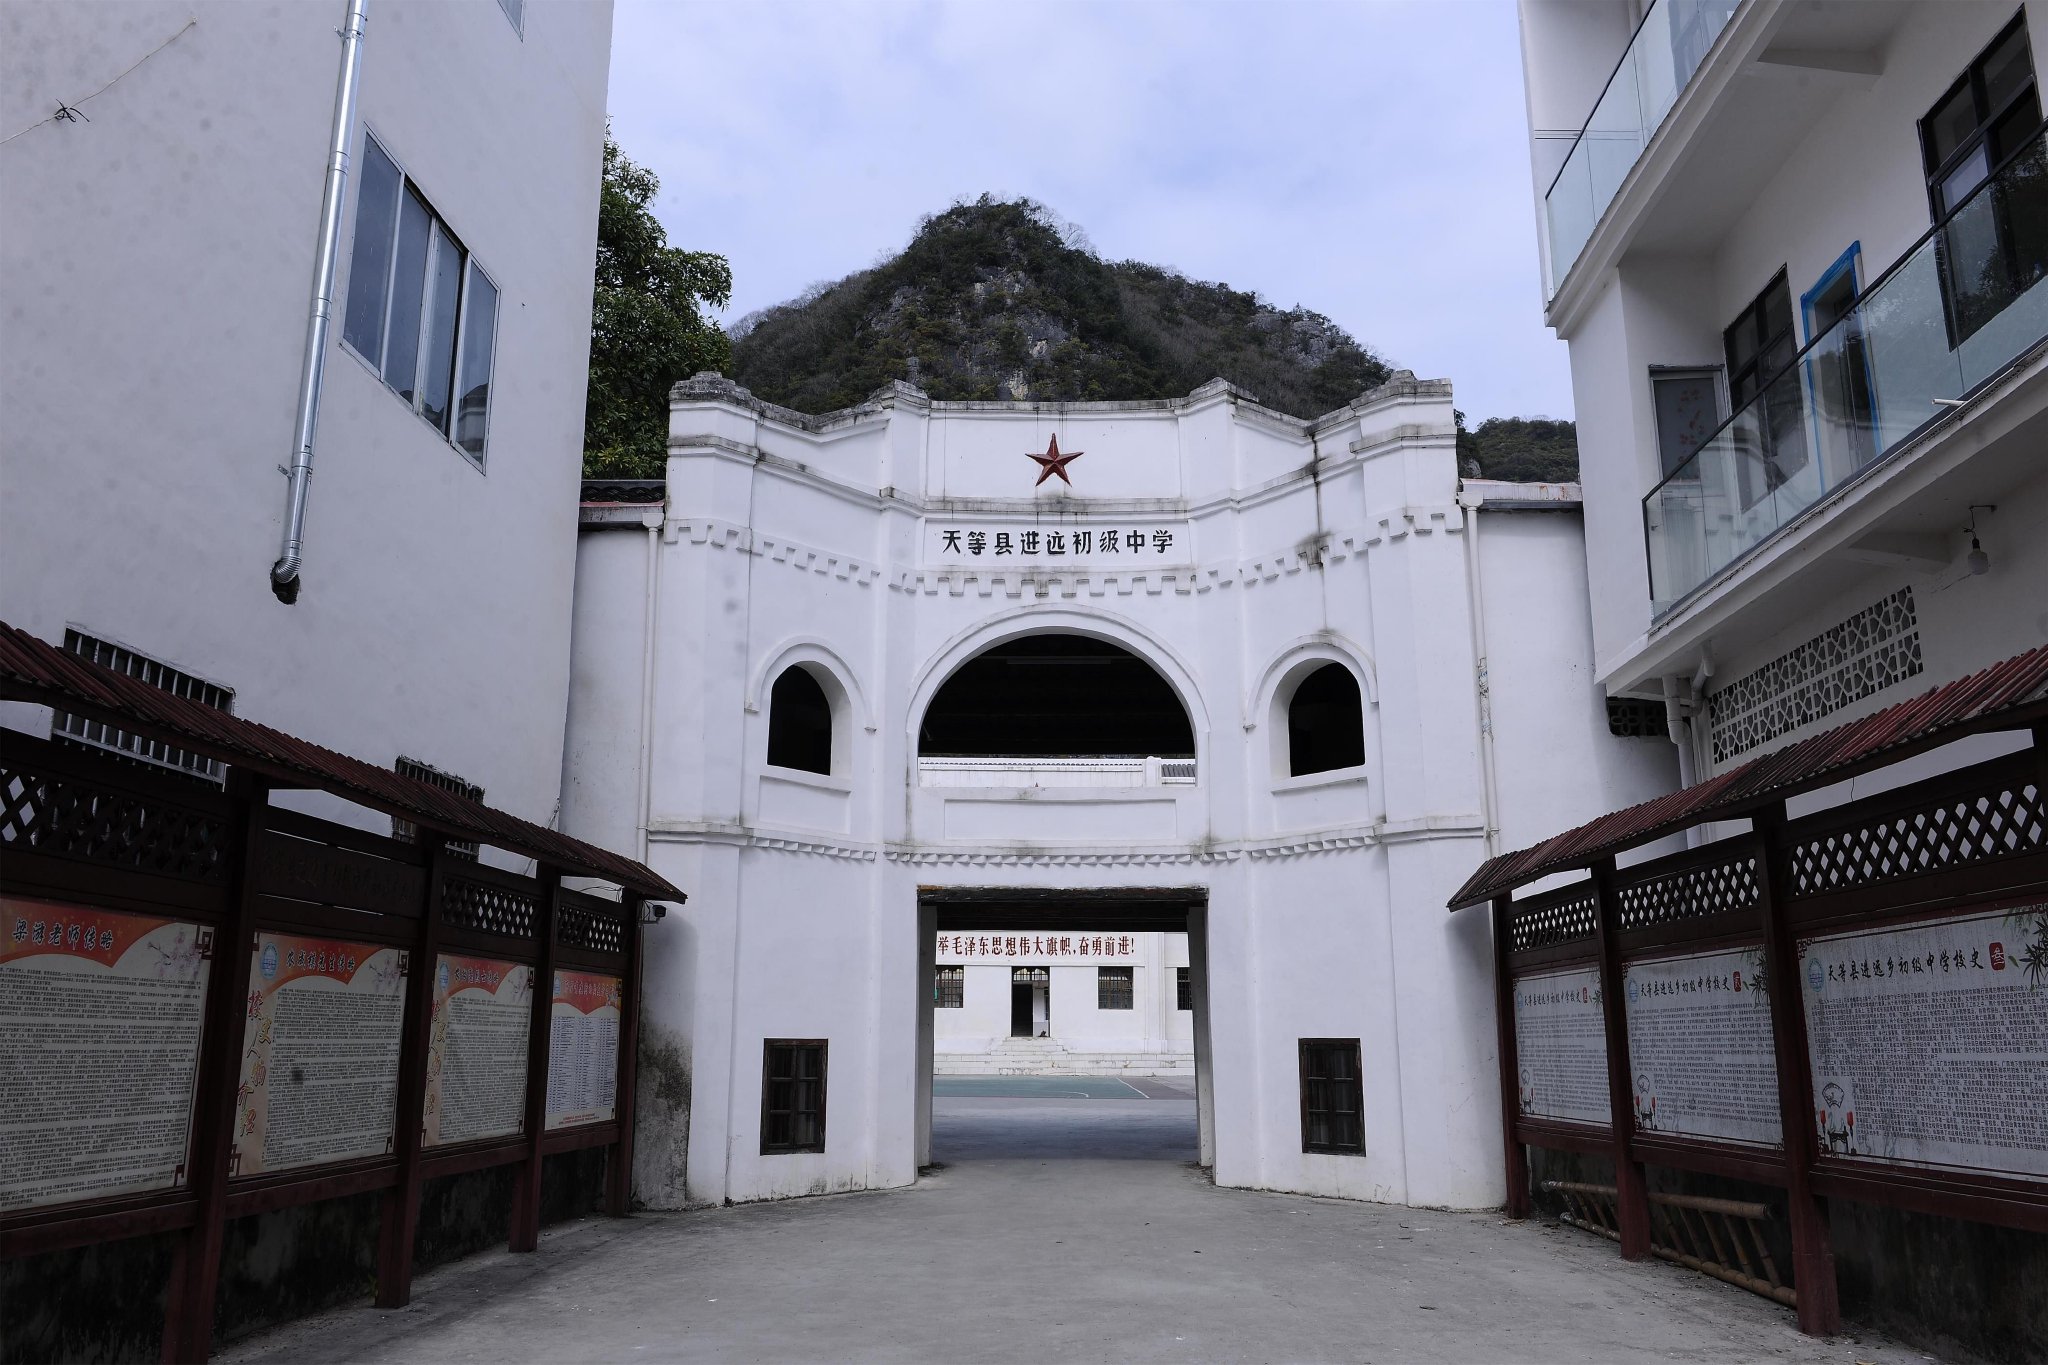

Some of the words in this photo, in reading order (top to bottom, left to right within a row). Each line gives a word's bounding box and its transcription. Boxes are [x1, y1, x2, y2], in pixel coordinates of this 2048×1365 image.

[942, 529, 1173, 556] 天等县进远初级中学
